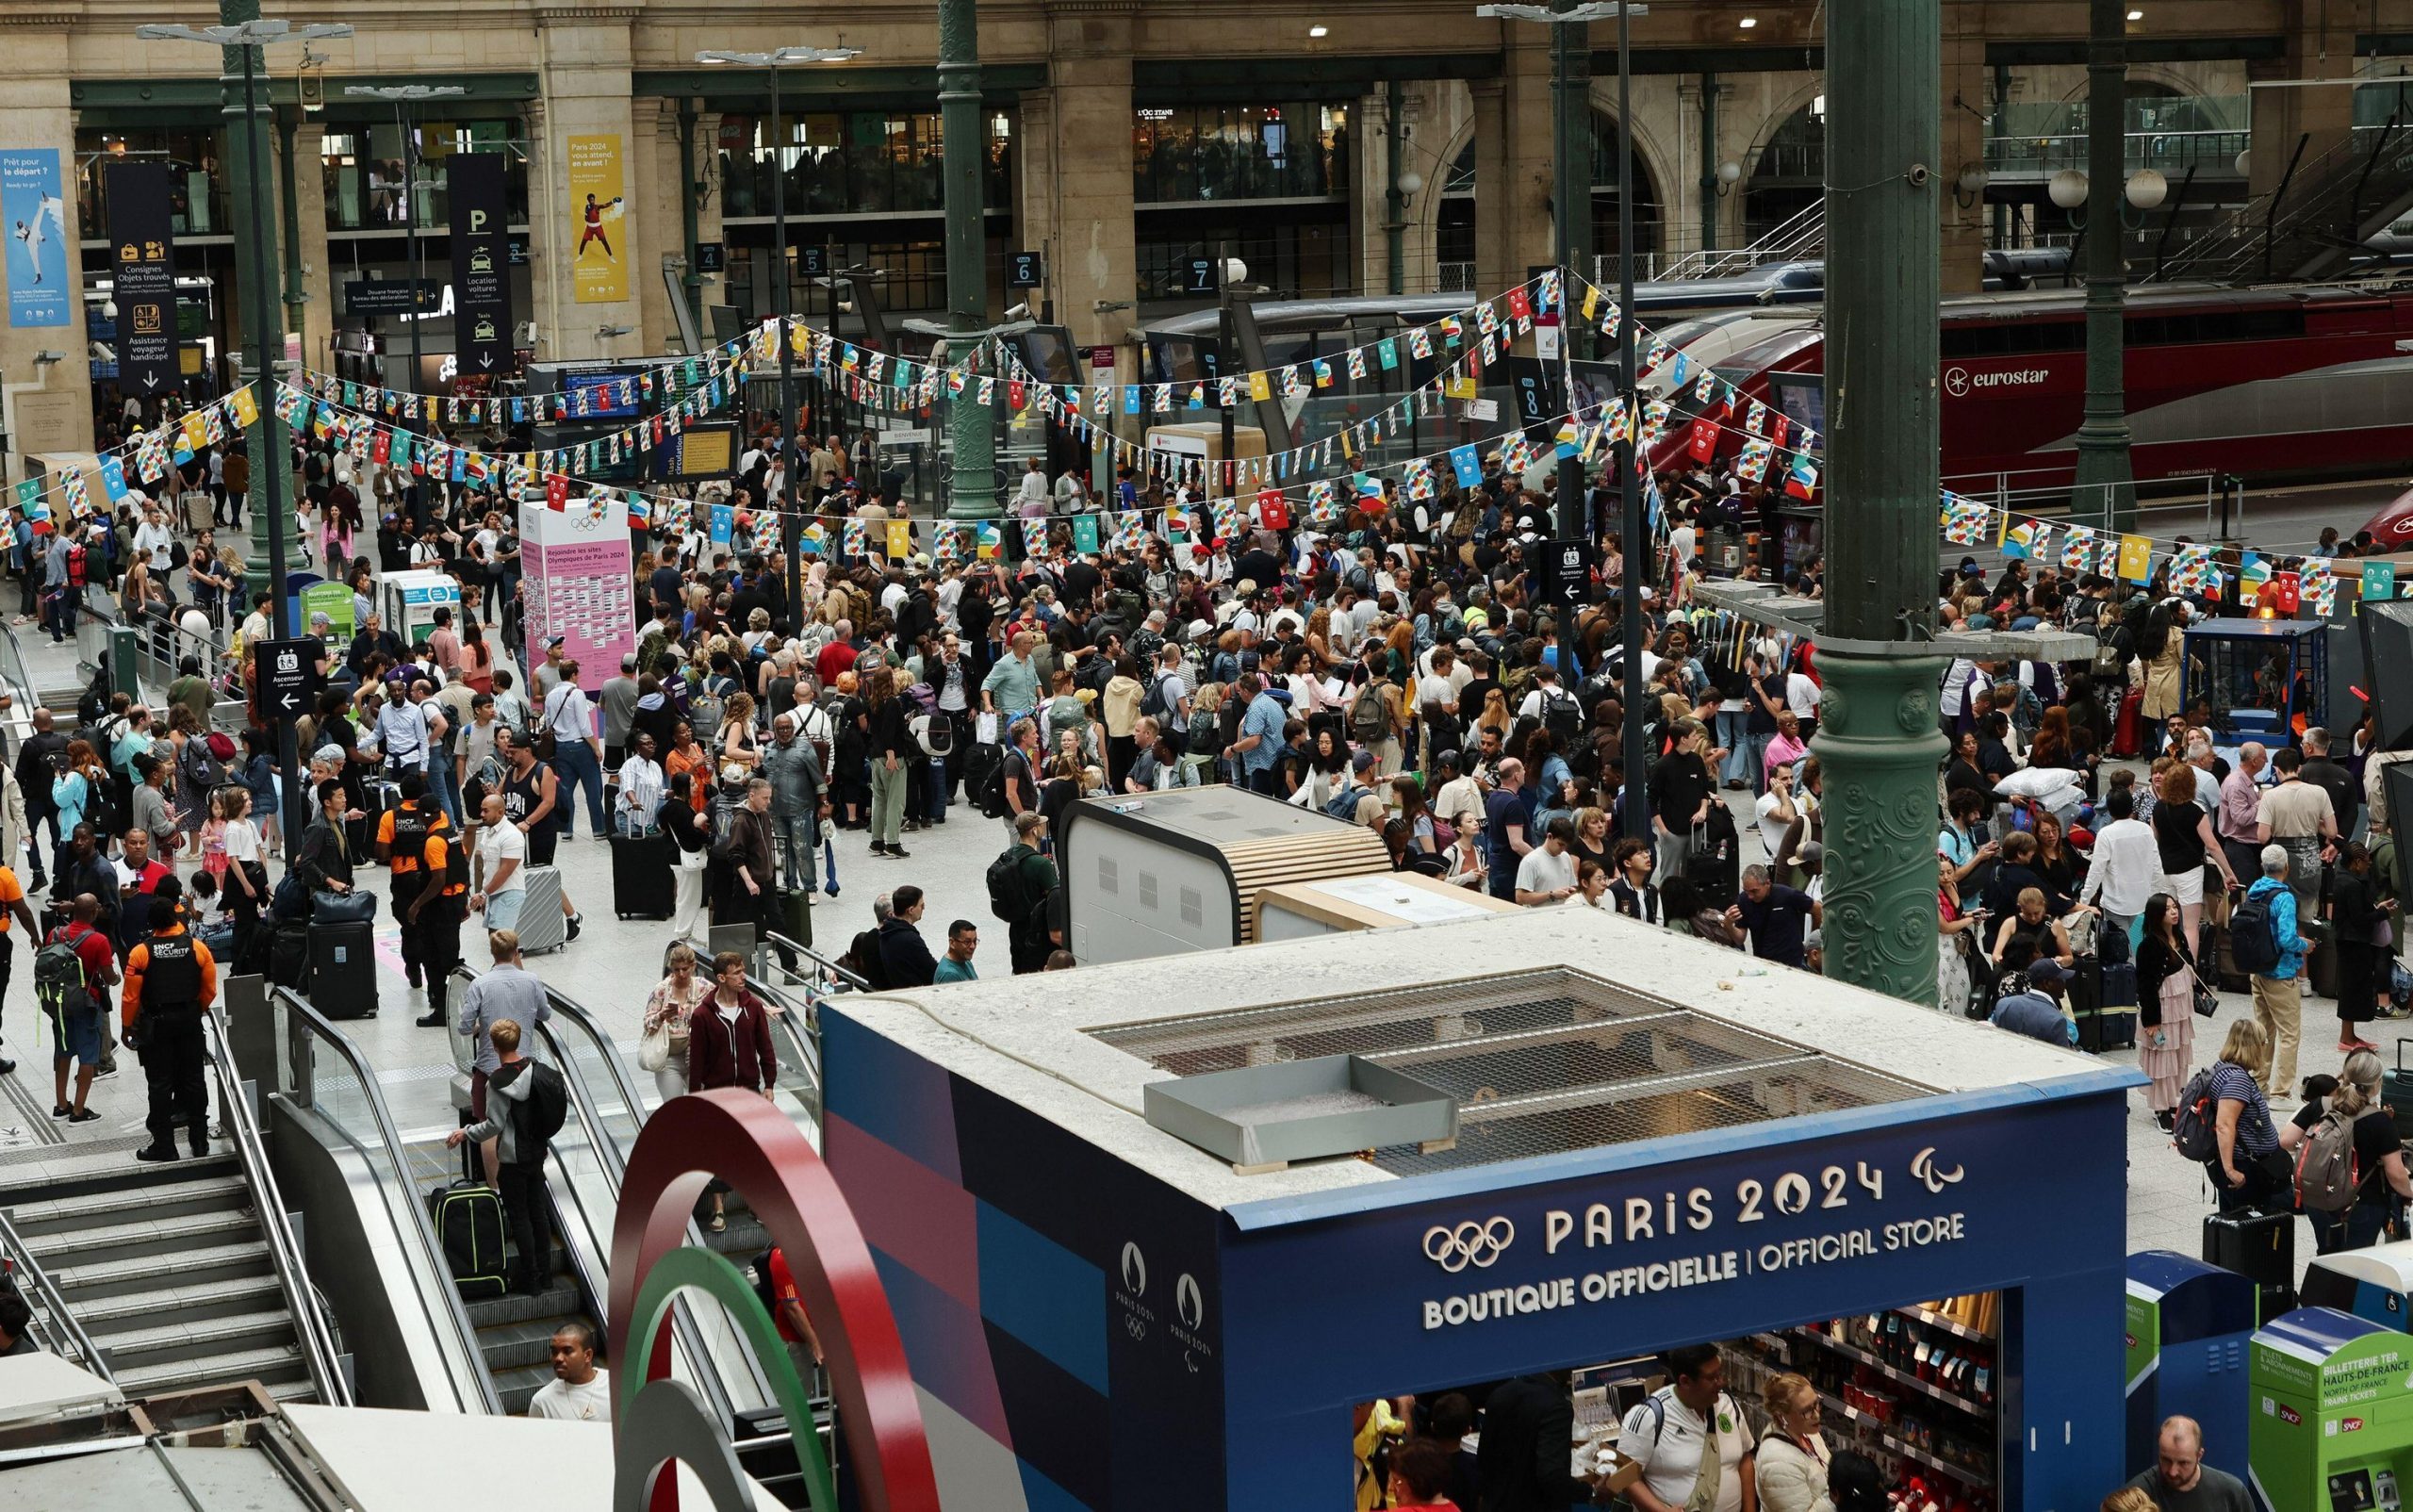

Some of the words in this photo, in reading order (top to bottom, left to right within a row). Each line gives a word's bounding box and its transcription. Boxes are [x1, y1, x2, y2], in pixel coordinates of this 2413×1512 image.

[22, 158, 40, 167] pour
[14, 168, 41, 177] départ
[471, 210, 486, 232] P
[704, 253, 714, 266] 4
[808, 256, 817, 271] 5
[125, 266, 162, 274] Consignes
[1019, 264, 1029, 280] 6
[1195, 270, 1206, 287] 7
[132, 346, 165, 354] voyageur
[1208, 366, 1217, 386] 7
[1522, 378, 1534, 386] Voie
[1974, 369, 2049, 386] eurostar
[1526, 390, 1537, 415] 8
[548, 556, 583, 565] Olympiques
[1737, 1161, 1882, 1222] 2024
[1423, 1277, 1575, 1329] BOUTIQUE
[1581, 1251, 1737, 1302] OFFICIELLE
[1758, 1229, 1878, 1271] OFFICIAL
[1883, 1212, 1964, 1251] STORE
[1116, 1291, 1135, 1310] PARIS
[1137, 1303, 1155, 1323] 2024
[1170, 1324, 1190, 1344] PARIS
[1192, 1337, 1211, 1356] 2024
[2260, 1348, 2282, 1361] BILLETS
[2266, 1357, 2313, 1381] ABONNEMENTS
[2323, 1356, 2379, 1376] BILLETTERIE
[2381, 1352, 2398, 1363] TER
[2323, 1360, 2410, 1387] HAUTS-DE-FRANCE
[2323, 1387, 2349, 1398] NORTH
[2350, 1384, 2359, 1392] OF
[2361, 1378, 2388, 1390] FRANCE
[2323, 1396, 2348, 1407] TRAINS
[2350, 1389, 2376, 1402] TICKETS
[2280, 1410, 2301, 1423] SNCF
[2342, 1420, 2361, 1432] SNCF
